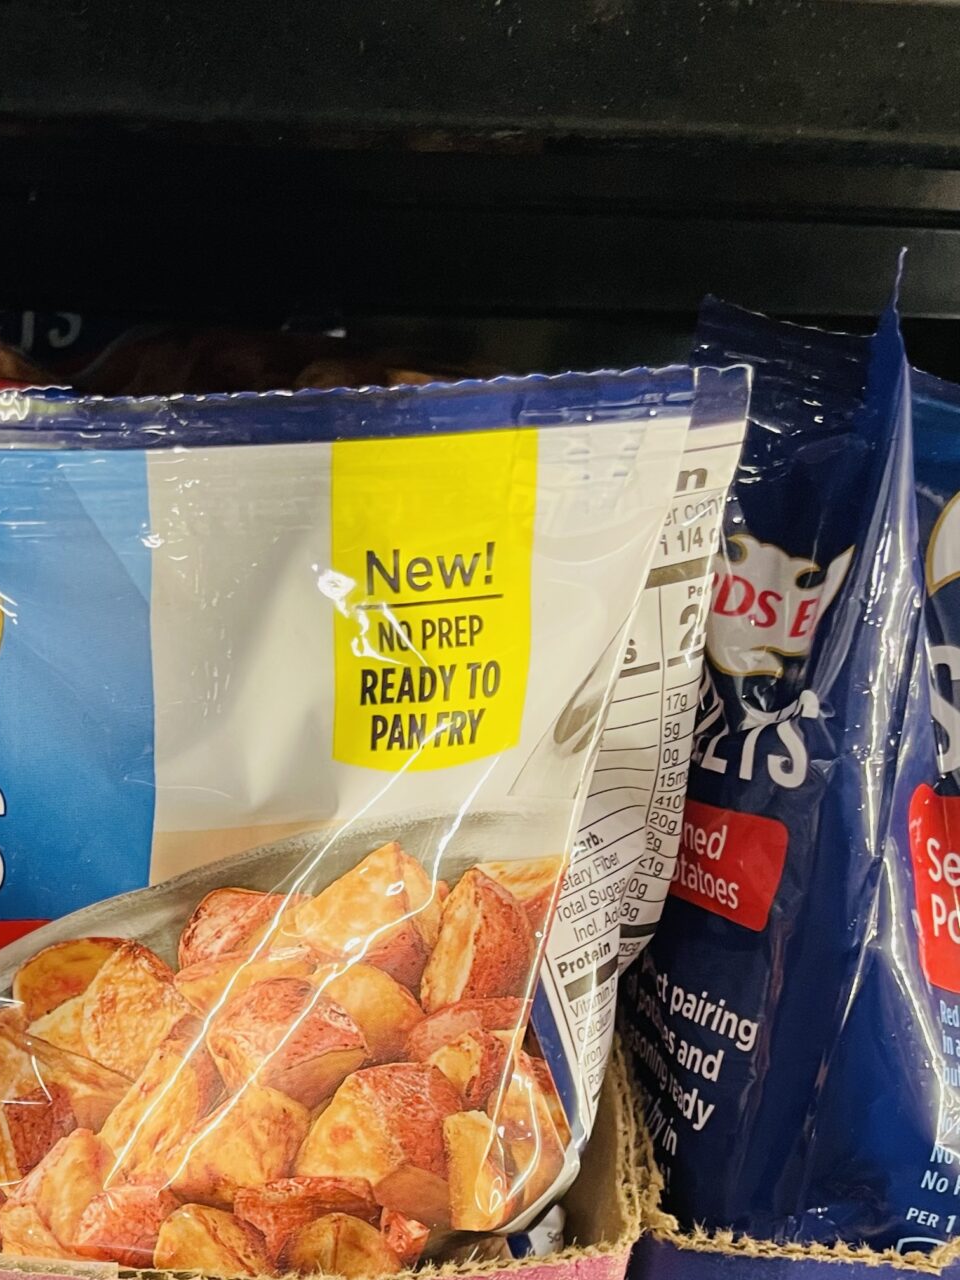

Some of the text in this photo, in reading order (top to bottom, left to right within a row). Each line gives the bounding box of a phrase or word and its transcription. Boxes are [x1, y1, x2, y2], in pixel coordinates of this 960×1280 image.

[365, 541, 496, 596] New!
[377, 614, 484, 652] NO PREP
[359, 660, 502, 706] READY TO
[666, 693, 689, 713] 17g
[370, 708, 488, 752] PAN FRY
[664, 722, 681, 740] 5g
[662, 748, 679, 766] 0g
[649, 811, 678, 836] 20g
[592, 851, 621, 876] Fiber
[555, 878, 649, 923] Total 0g
[573, 902, 641, 944] Incl. 3g
[556, 940, 612, 979] Protein
[569, 983, 611, 1019] Vitamin
[670, 984, 760, 1052] pairing
[576, 1007, 613, 1044] Calcium
[583, 1045, 603, 1068] Iron
[676, 1037, 726, 1084] and
[668, 1073, 717, 1132] ready
[920, 1168, 949, 1194] No
[905, 1206, 940, 1230] PER
